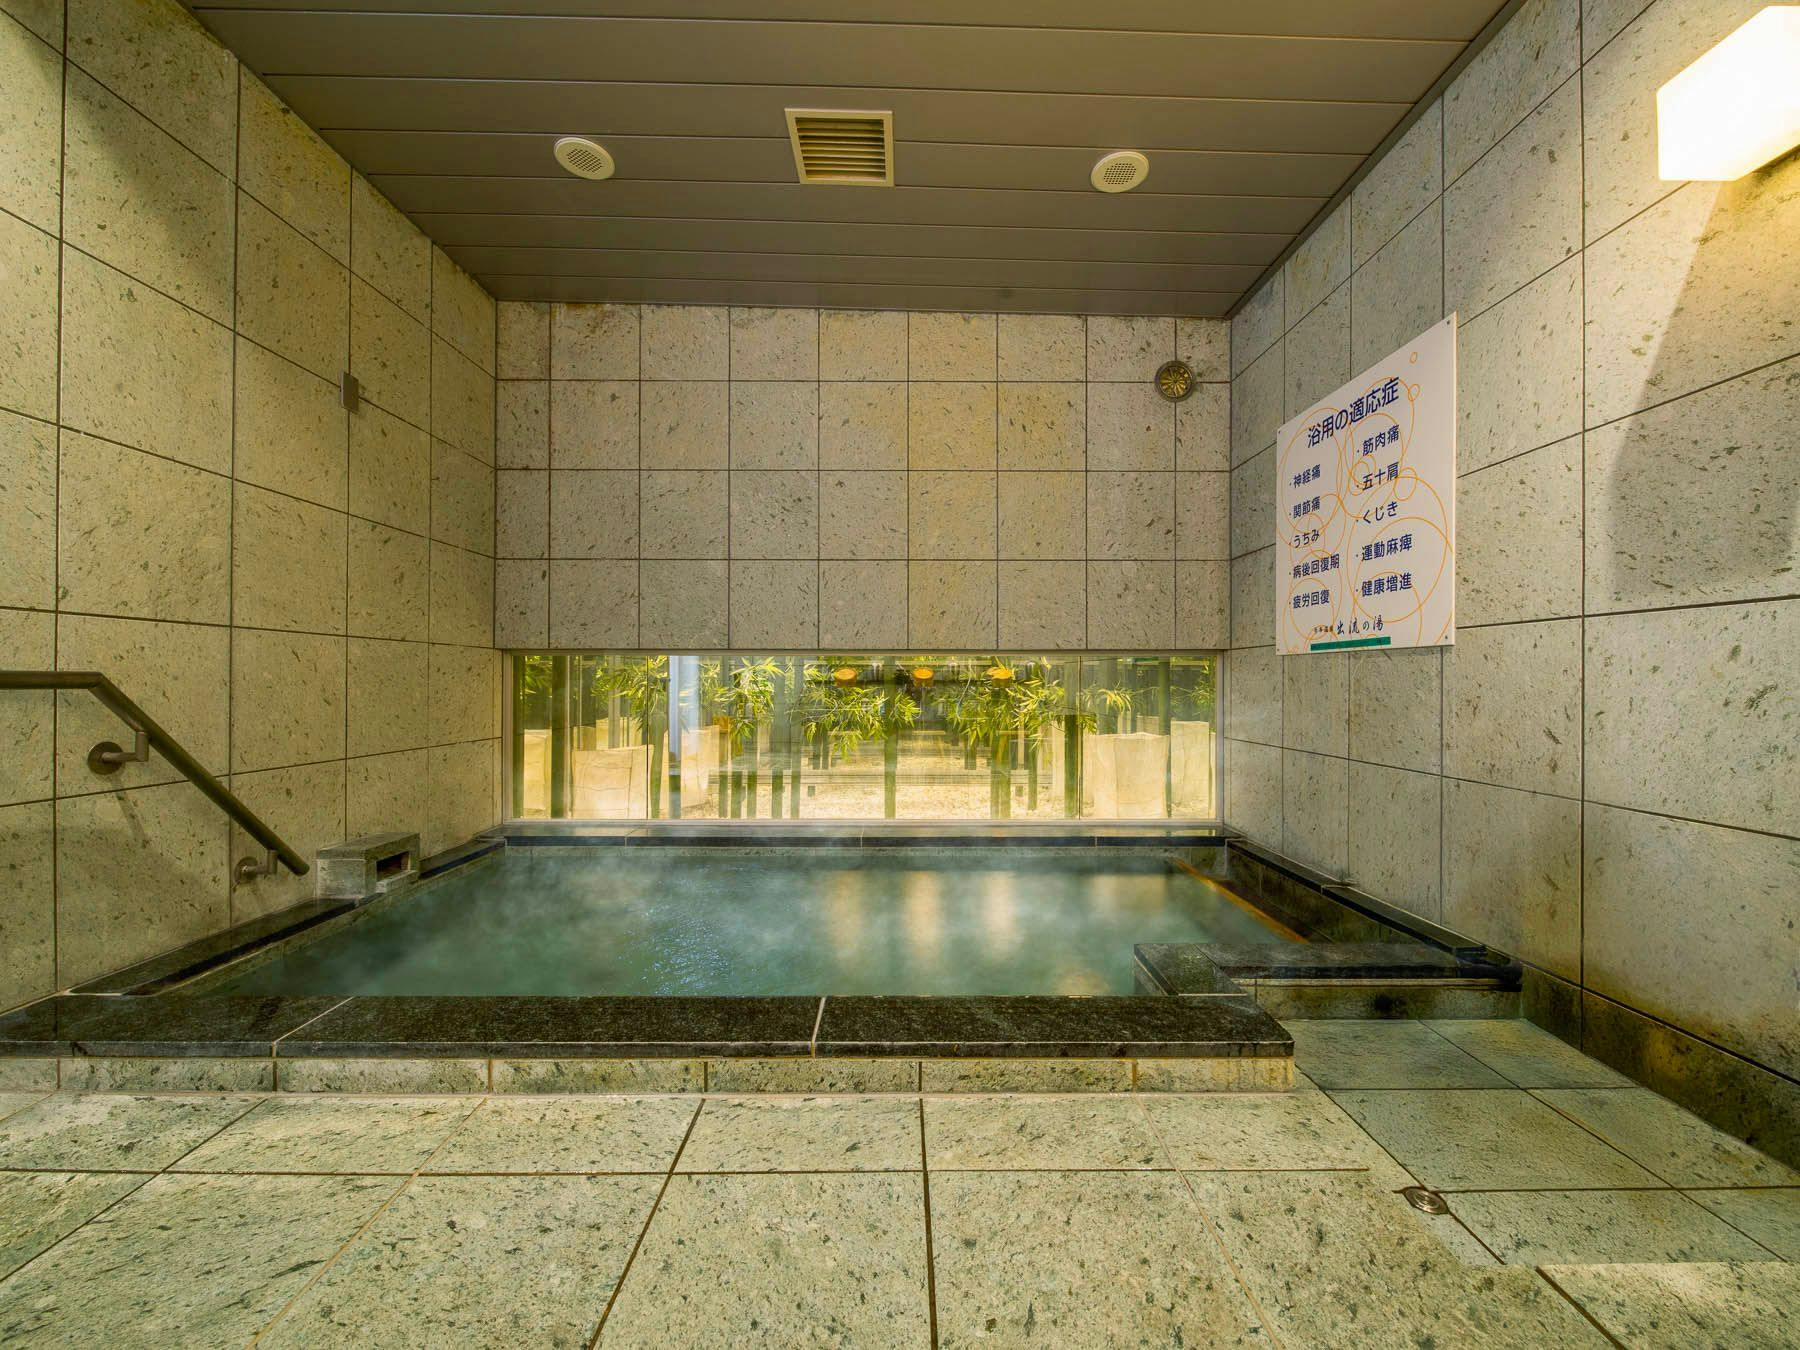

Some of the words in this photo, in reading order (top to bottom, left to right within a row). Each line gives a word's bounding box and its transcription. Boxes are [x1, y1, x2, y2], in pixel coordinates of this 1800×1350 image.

[1307, 376, 1400, 448] 浴用の適応症
[1362, 424, 1400, 456] 筋肉痛
[1293, 463, 1321, 488] 神経痛
[1362, 461, 1399, 491] 五十肩
[1293, 496, 1320, 519] 関節痛
[1363, 501, 1398, 524] くじき
[1293, 529, 1320, 549] うちみ
[1361, 533, 1413, 562] 運動麻痺
[1293, 553, 1340, 579] 病後回復期
[1361, 572, 1412, 598] 健康増進
[1292, 589, 1330, 609] 疲労回復
